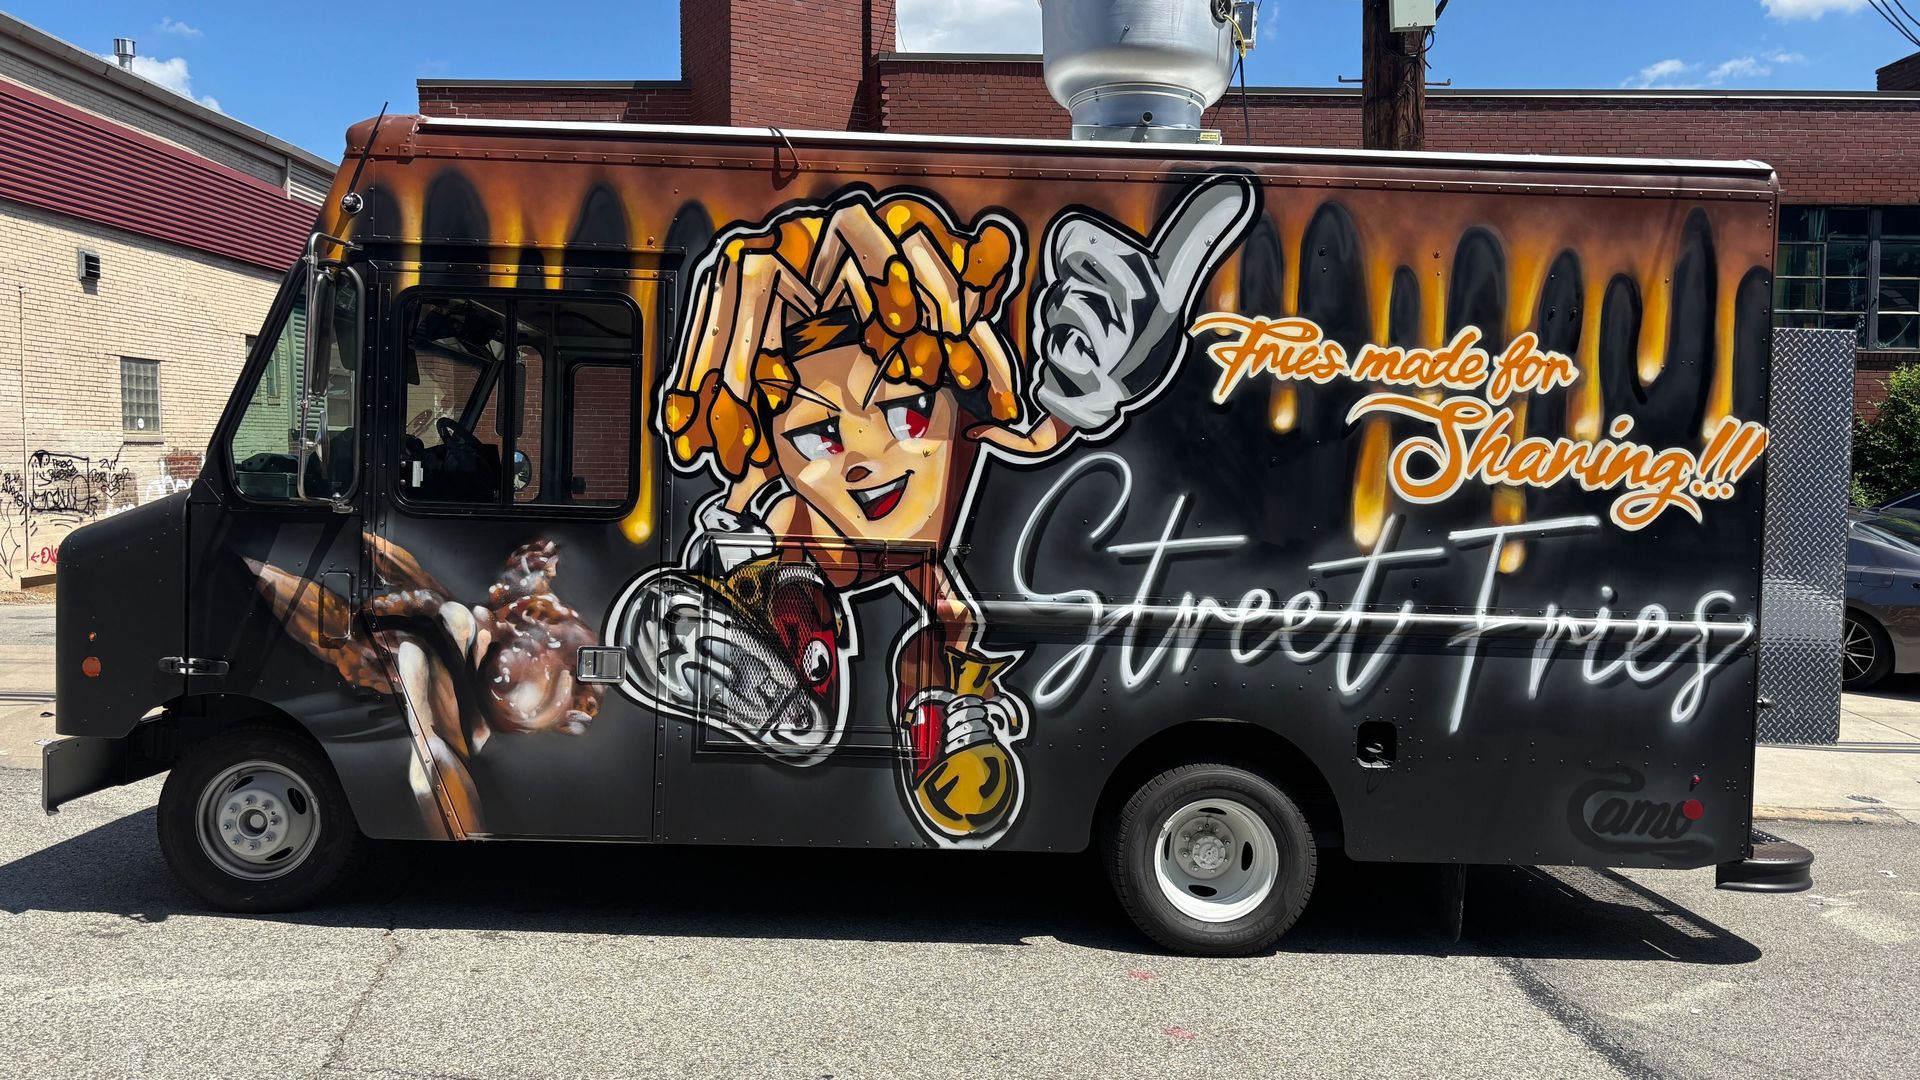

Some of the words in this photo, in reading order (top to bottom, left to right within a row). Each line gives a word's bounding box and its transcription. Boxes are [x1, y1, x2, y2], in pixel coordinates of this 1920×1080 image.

[1189, 312, 1348, 404] Fries
[1351, 325, 1488, 390] made
[1486, 331, 1579, 405] for
[1346, 394, 1769, 531] Sharing!!!
[1014, 452, 1445, 706] Street
[1448, 515, 1754, 734] Fries
